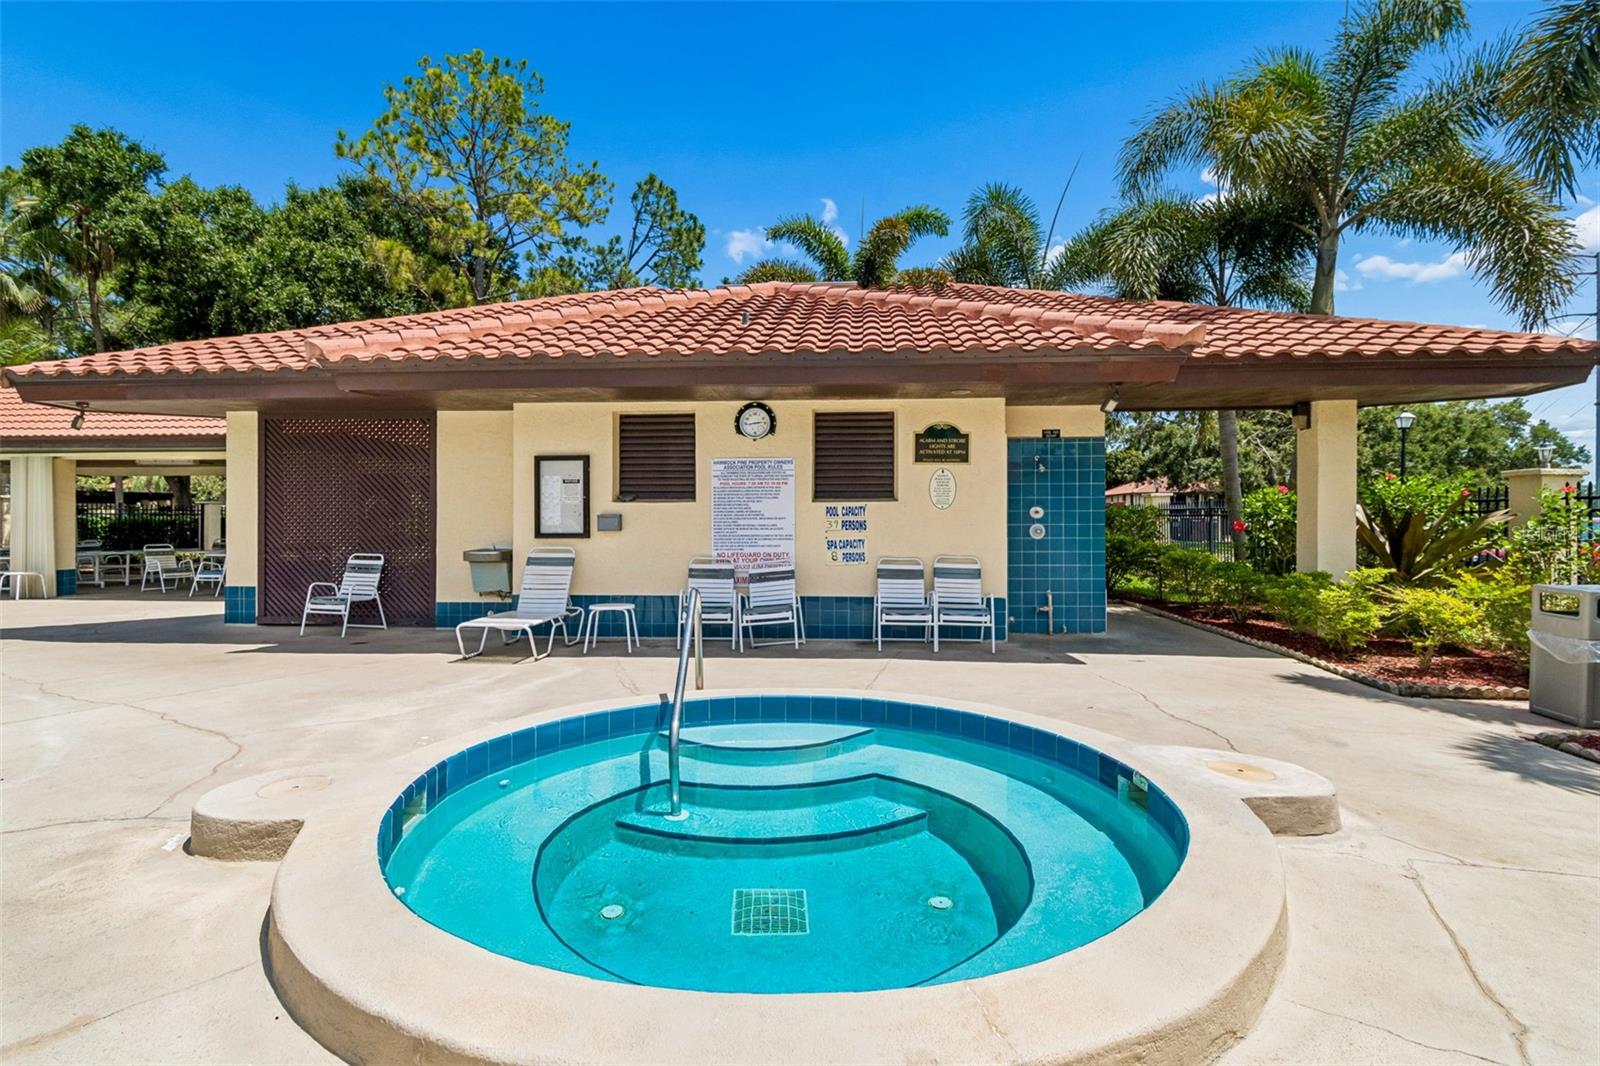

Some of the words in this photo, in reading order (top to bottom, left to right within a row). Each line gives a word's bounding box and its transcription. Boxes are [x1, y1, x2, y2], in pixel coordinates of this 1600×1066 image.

[825, 506, 839, 517] POOL
[841, 506, 866, 517] CAPACITY
[841, 519, 867, 531] PERSONS
[826, 539, 838, 550] SPA
[839, 538, 865, 549] CAPACITY
[831, 551, 838, 561] 8
[842, 552, 866, 562] PERSONS
